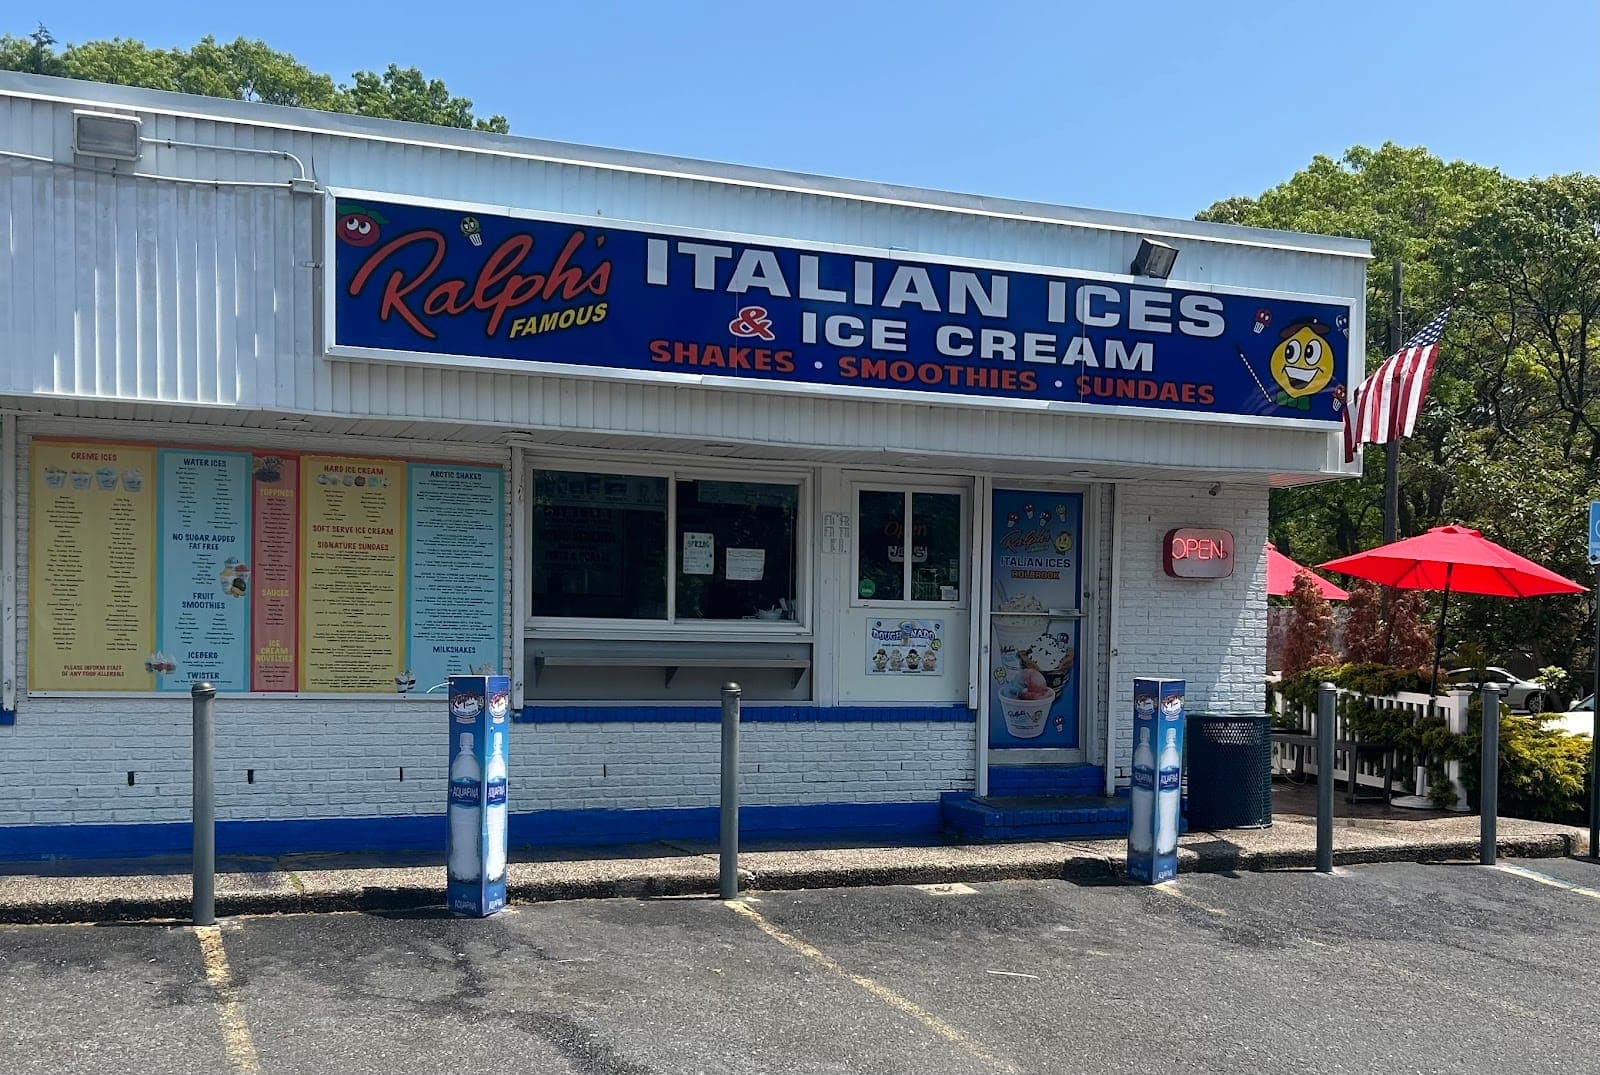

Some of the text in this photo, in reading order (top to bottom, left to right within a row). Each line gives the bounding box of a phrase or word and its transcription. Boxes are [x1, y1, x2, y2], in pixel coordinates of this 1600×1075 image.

[349, 229, 612, 339] Ralph's
[646, 238, 1226, 338] ITALIAN ICES
[509, 302, 608, 339] FAMOUS
[728, 305, 1155, 373] & ICE CREAM
[648, 339, 1215, 405] SHAKES SMOOTHIES SUNDAES
[71, 452, 117, 462] CREME ICES
[184, 458, 209, 466] WATER
[324, 464, 384, 475] HARD ICE CREAM
[430, 470, 482, 480] ARCTIC SHAKES
[312, 525, 330, 533] SOFT
[331, 526, 354, 534] SERVE
[367, 528, 394, 536] CREAM
[172, 533, 236, 543] NO SUGAR ADDED
[202, 543, 219, 551] FREE
[317, 541, 389, 551] SIGNATURE SUNDAES
[1172, 538, 1223, 559] OPEN
[1001, 556, 1071, 568] ITALIAN ICES
[193, 592, 215, 600] FRUIT
[262, 589, 289, 597] SAUCES
[182, 601, 225, 609] SMOOTHIES
[188, 651, 218, 659] ICEBERG
[432, 646, 476, 654] MILKSHAKES
[186, 671, 220, 680] TWISTER
